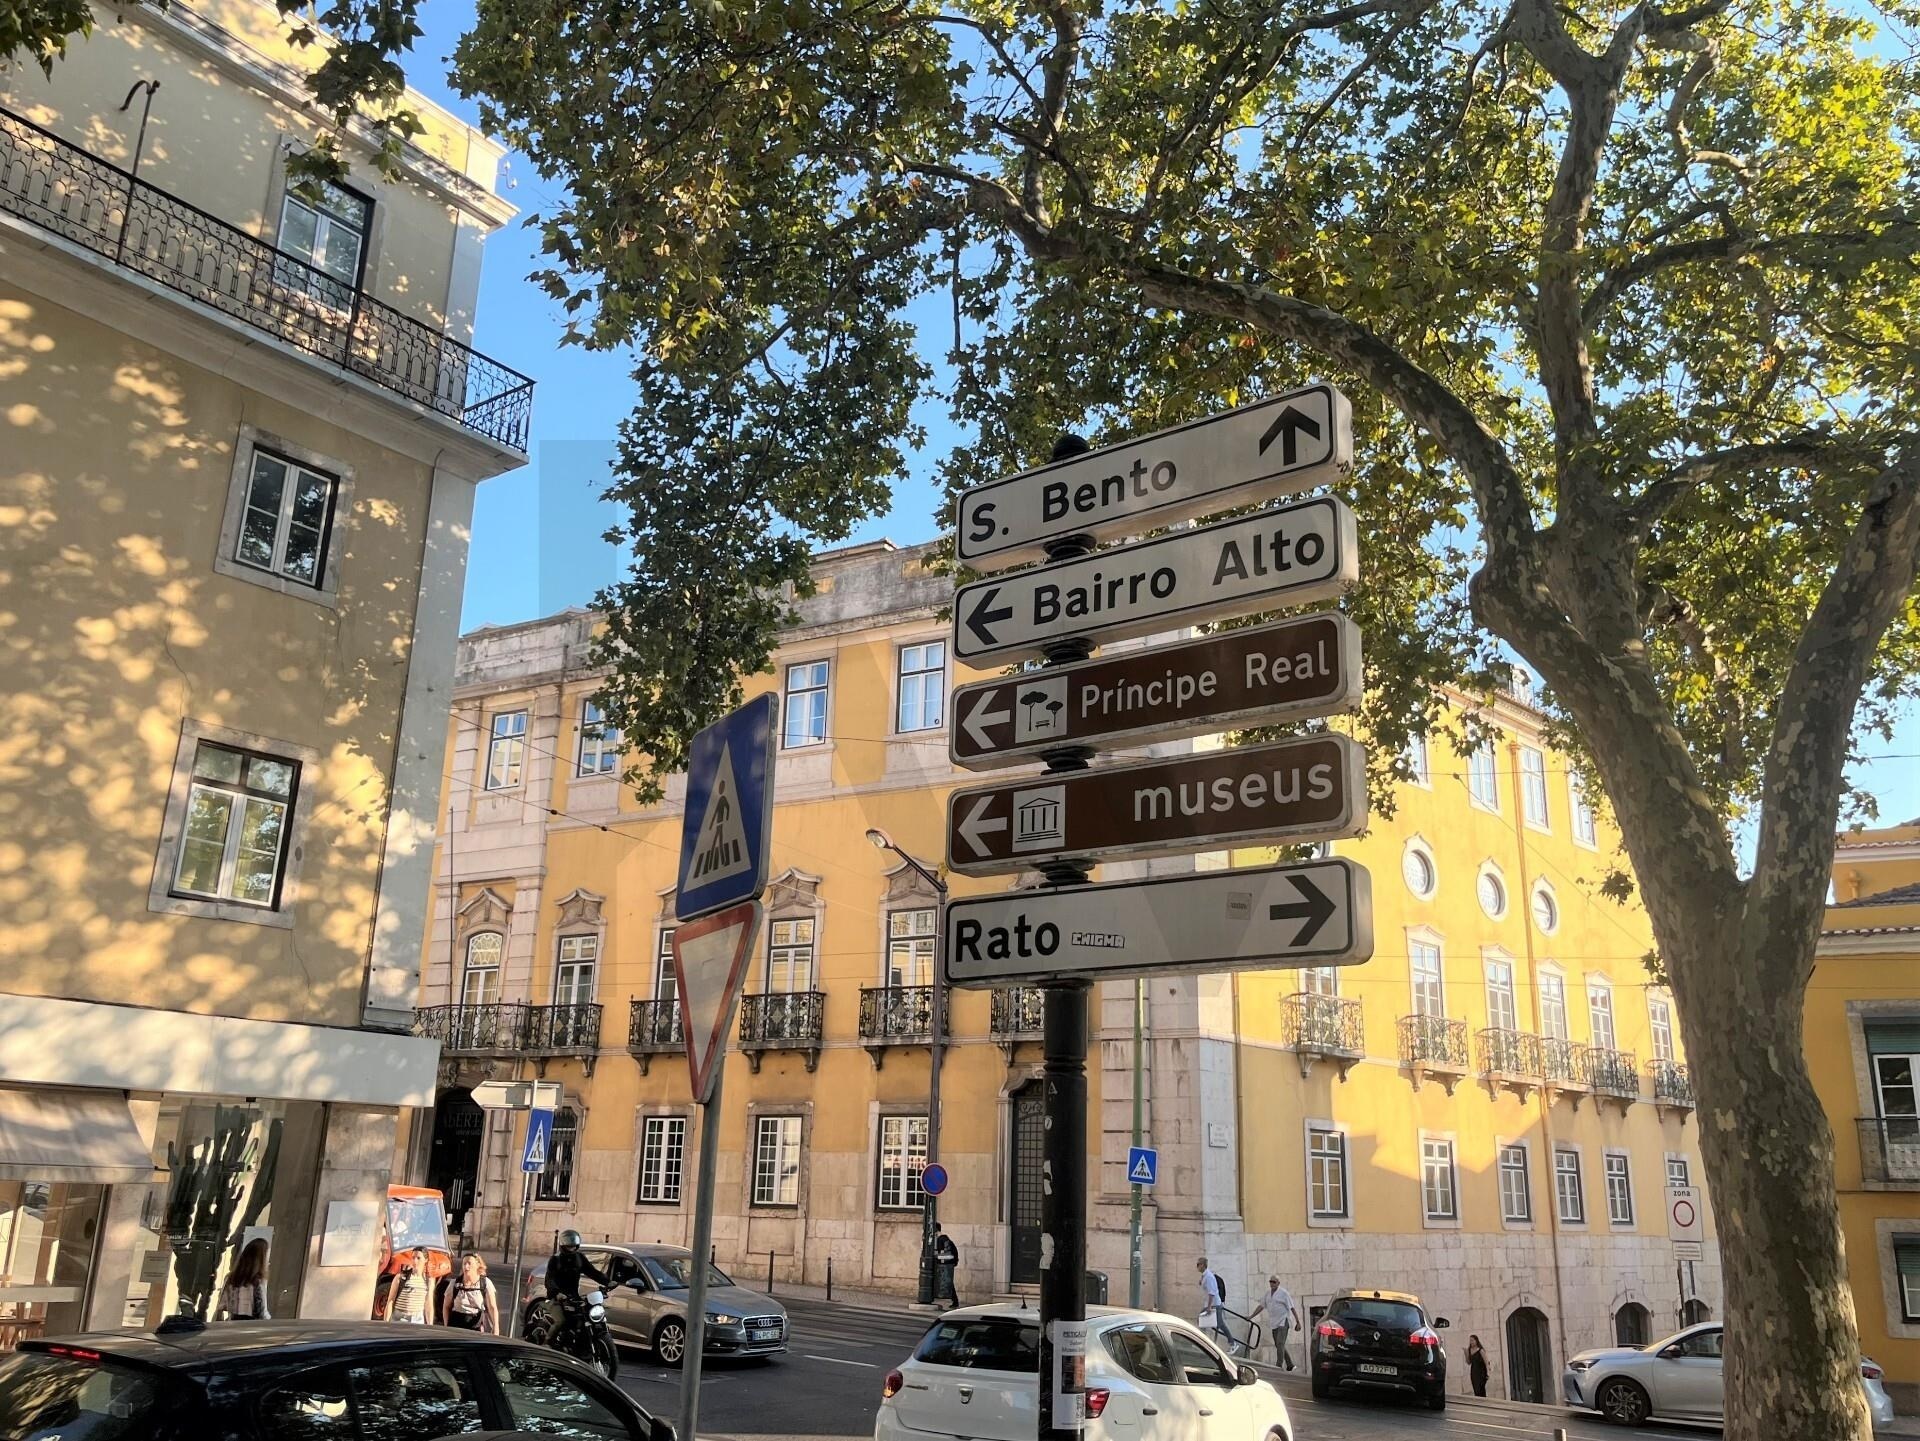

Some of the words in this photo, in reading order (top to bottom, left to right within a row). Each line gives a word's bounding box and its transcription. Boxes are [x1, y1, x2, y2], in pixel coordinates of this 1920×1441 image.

[969, 502, 1010, 543] S.
[1042, 458, 1177, 524] Bento
[1033, 565, 1177, 625] Bairro
[1212, 528, 1325, 587] Alto
[1081, 669, 1217, 719] Príncipe
[1245, 639, 1331, 689] Real
[1133, 763, 1334, 822] museus
[954, 913, 1060, 963] Rato
[1071, 932, 1126, 949] ENIGMA
